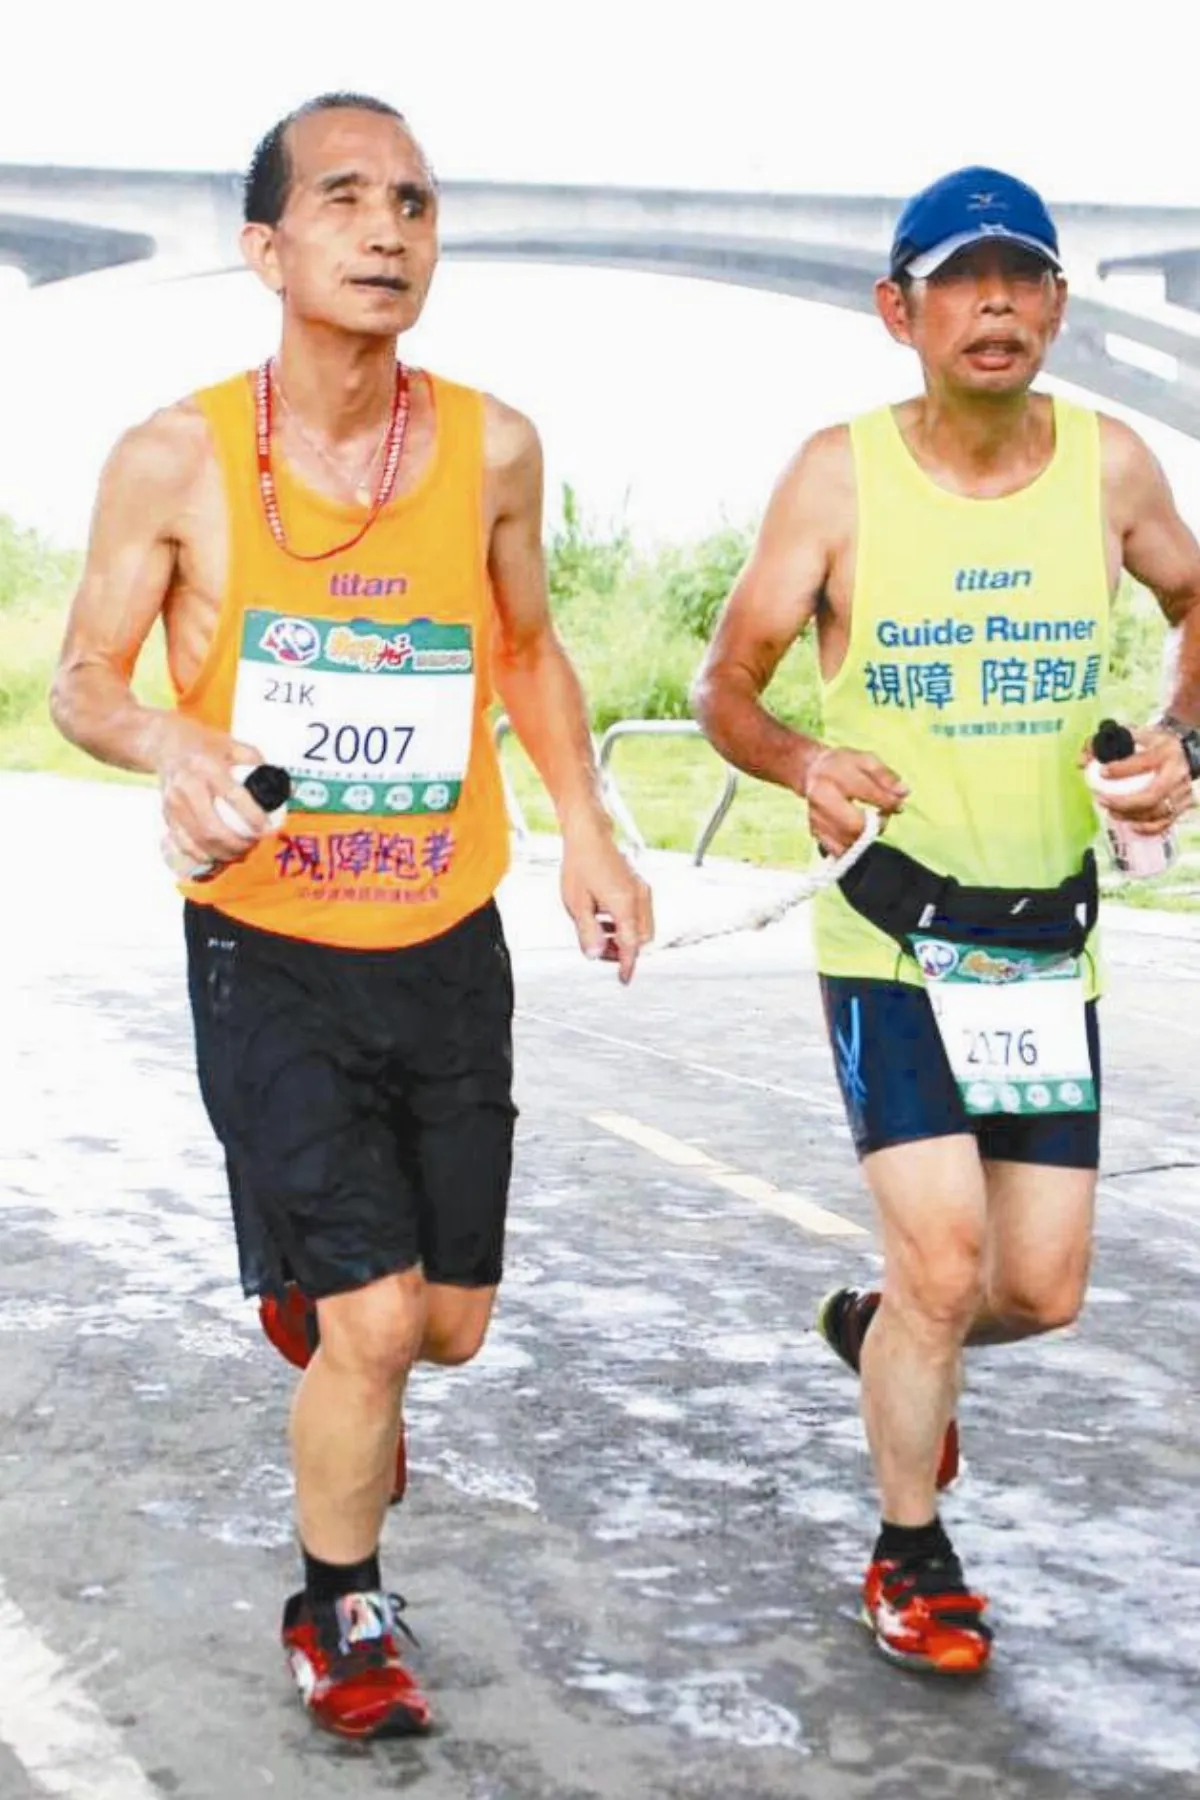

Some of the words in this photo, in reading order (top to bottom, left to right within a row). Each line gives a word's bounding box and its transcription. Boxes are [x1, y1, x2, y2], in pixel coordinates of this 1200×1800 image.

[330, 572, 407, 596] titan
[956, 568, 1031, 591] titan
[877, 619, 974, 647] Guide
[986, 615, 1096, 641] Runner
[264, 678, 315, 706] 21K
[864, 661, 953, 709] 視障
[304, 723, 415, 765] 2007
[962, 1028, 1038, 1067] 2176
